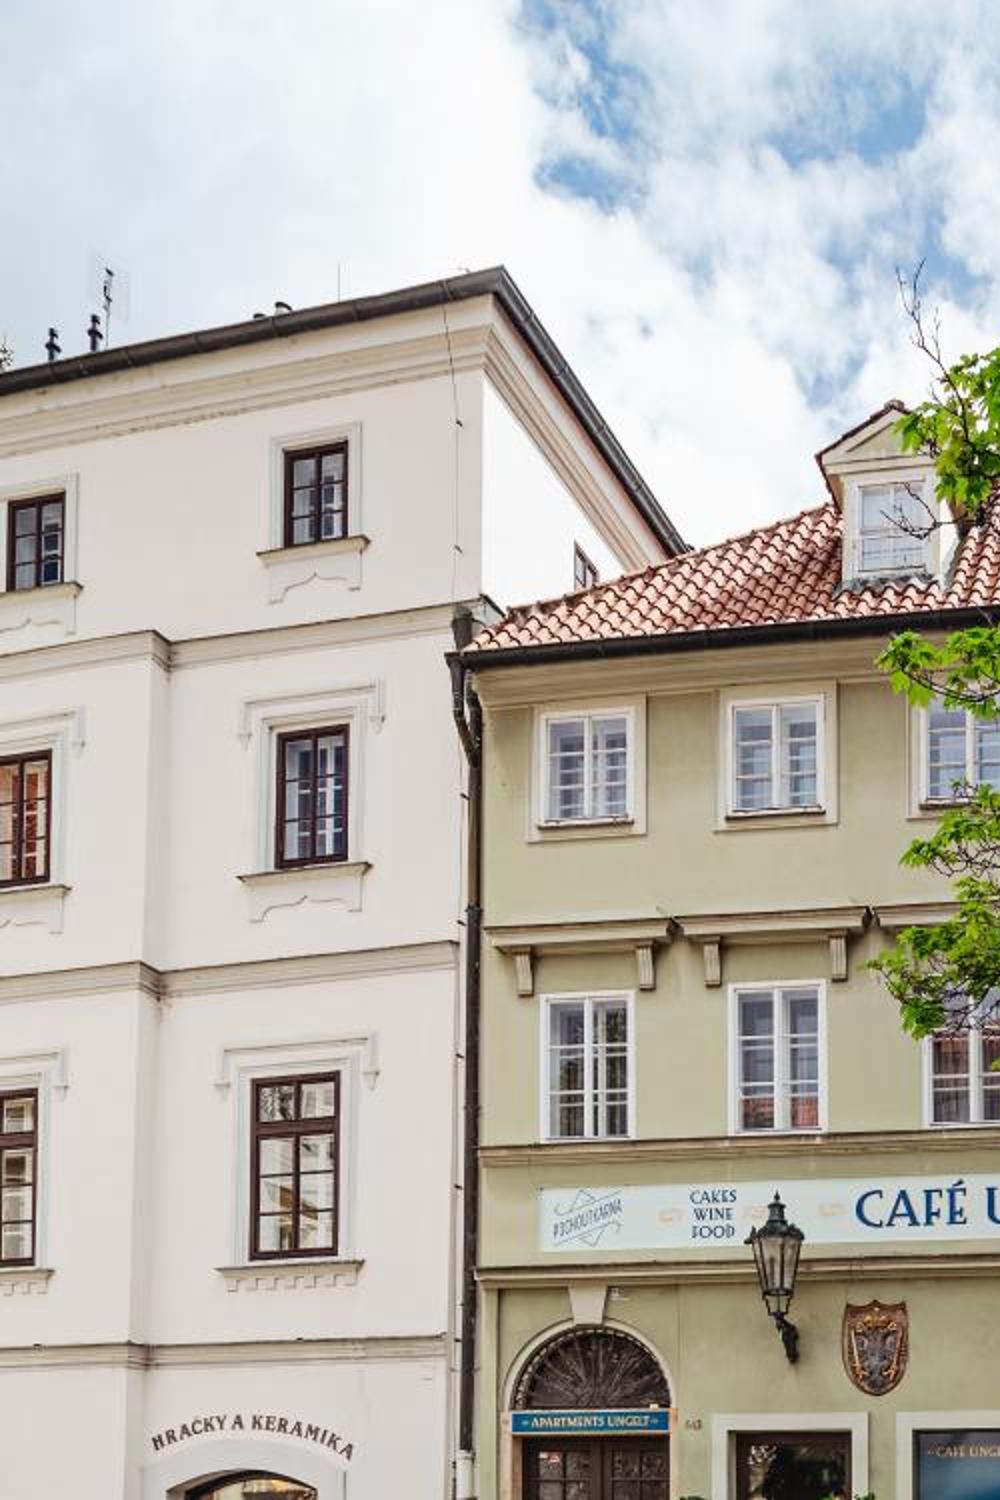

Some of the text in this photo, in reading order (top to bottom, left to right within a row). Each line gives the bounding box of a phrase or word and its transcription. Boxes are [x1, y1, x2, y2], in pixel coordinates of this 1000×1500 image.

[689, 1189, 737, 1205] CAKES
[855, 1178, 968, 1228] CAFÉ
[693, 1207, 735, 1221] WINE
[691, 1225, 735, 1239] FOOD
[531, 1415, 650, 1428] APARTMENTS UNGELT
[231, 1414, 245, 1430] A
[251, 1415, 355, 1461] KERAMIKA
